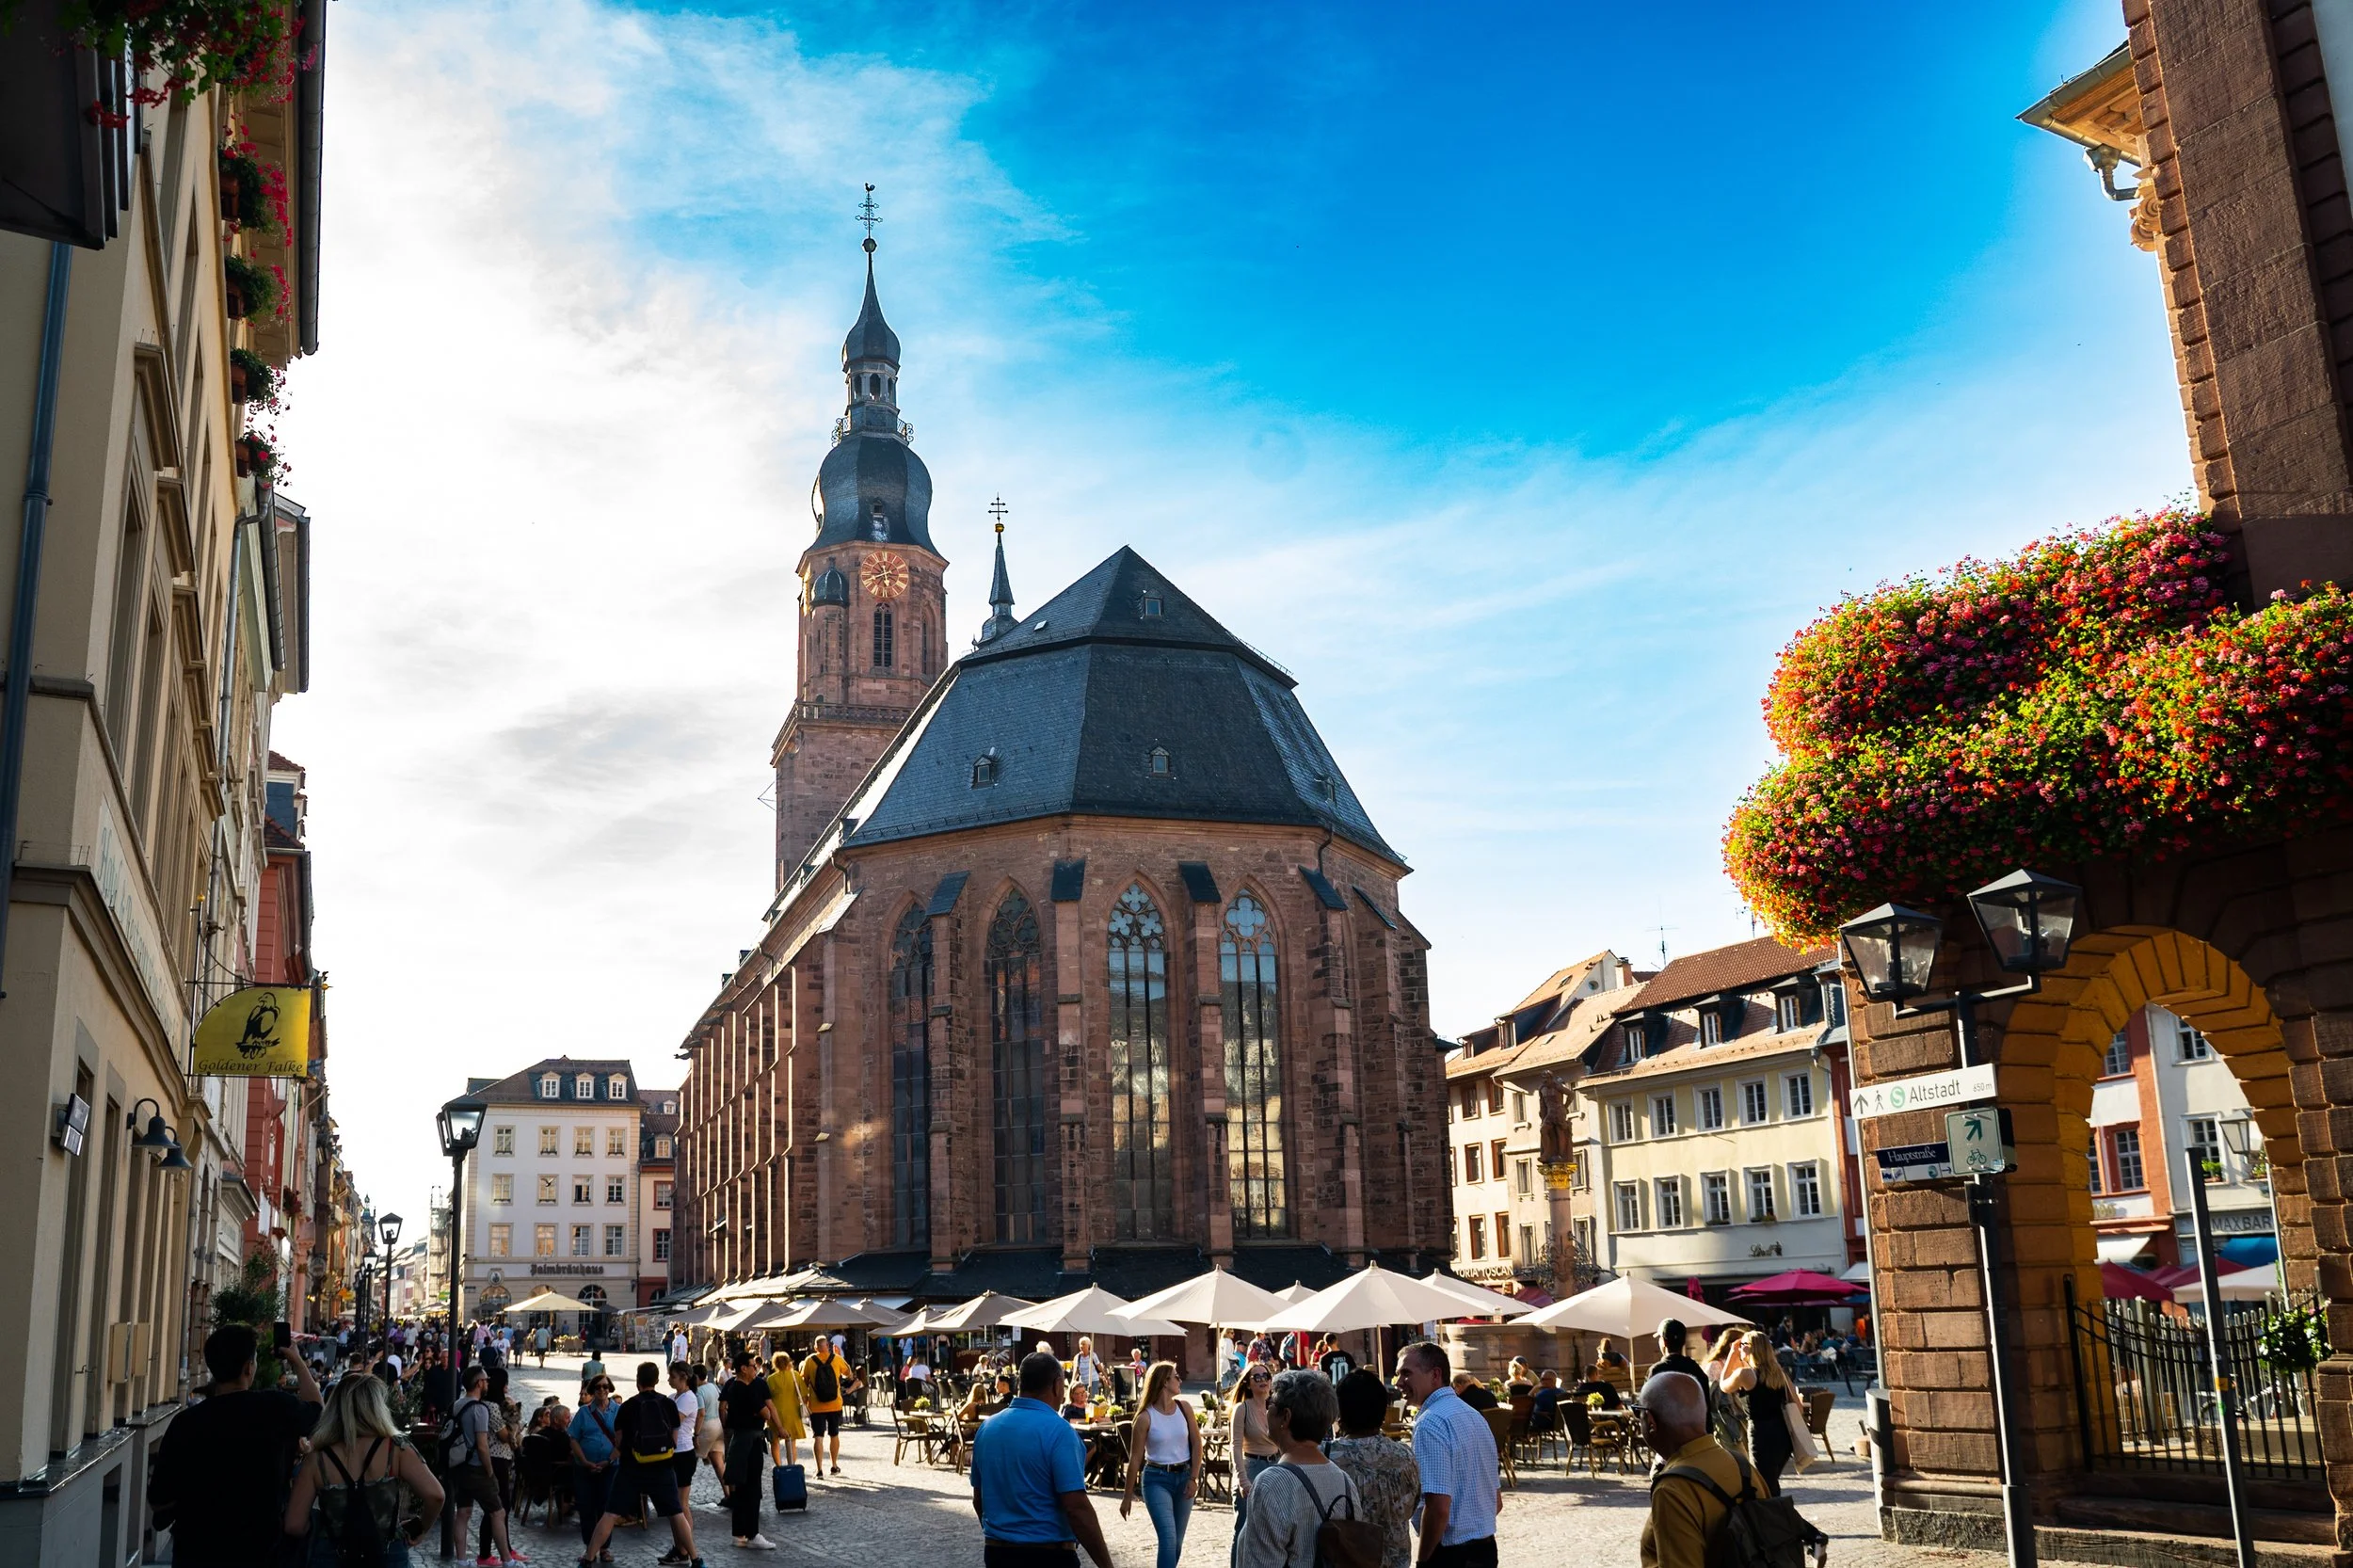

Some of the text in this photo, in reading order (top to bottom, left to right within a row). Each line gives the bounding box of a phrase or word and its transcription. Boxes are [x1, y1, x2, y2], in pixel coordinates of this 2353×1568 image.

[198, 1060, 303, 1073] Goldener Falke
[1910, 1080, 1961, 1104] Altstadt
[1973, 1082, 1985, 1092] 650
[1887, 1145, 1937, 1163] Hauptstraße
[1330, 1362, 1349, 1385] 10
